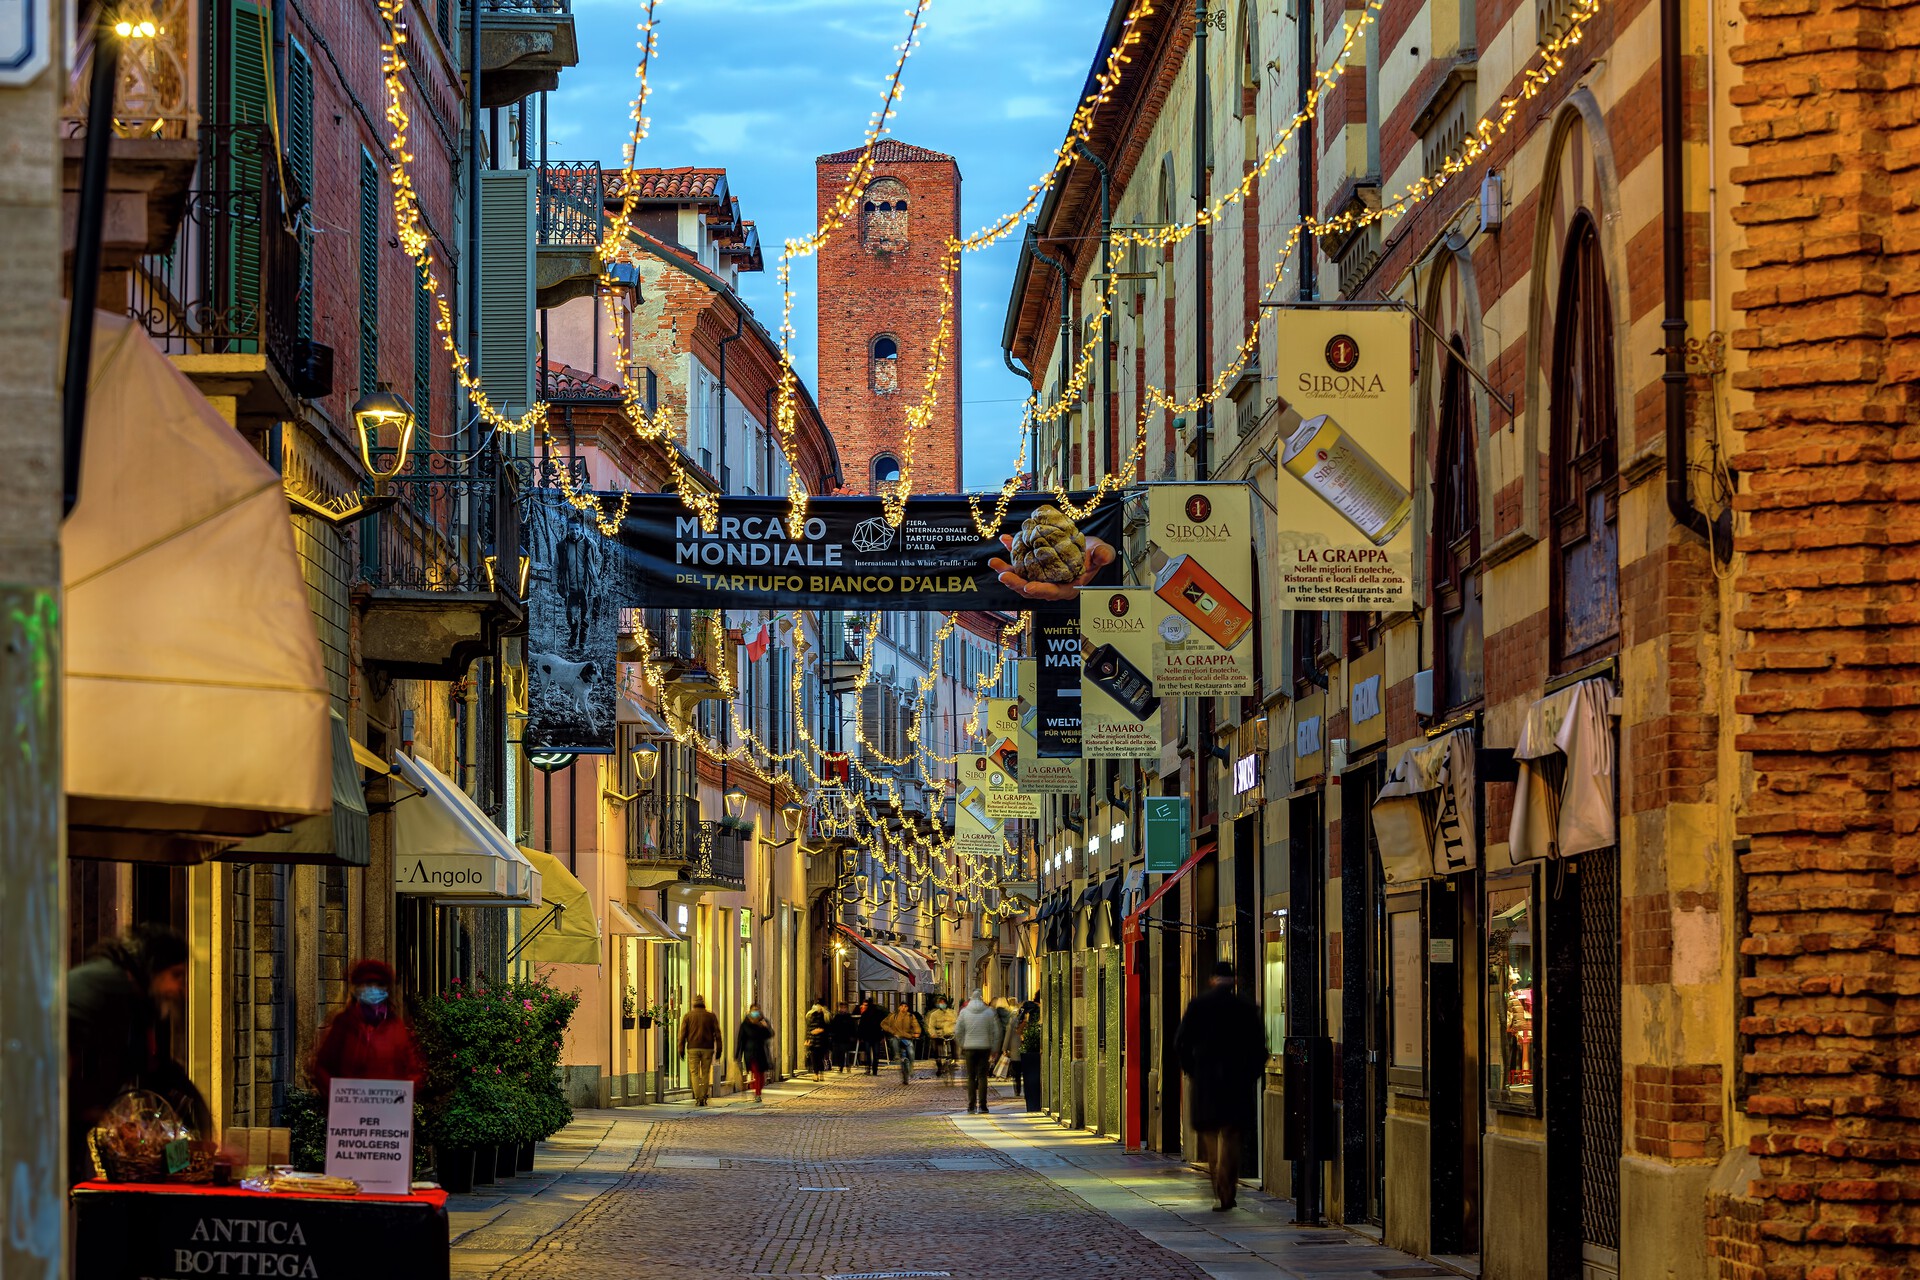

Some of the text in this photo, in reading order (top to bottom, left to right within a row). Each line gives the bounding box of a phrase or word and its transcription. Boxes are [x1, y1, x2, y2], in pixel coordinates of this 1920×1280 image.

[1298, 372, 1386, 393] SIBONA
[1313, 446, 1349, 482] SIBONA
[1165, 523, 1231, 538] SIBONA
[676, 542, 843, 566] MONDIALE
[1298, 549, 1388, 563] LA GRAPPA
[855, 559, 898, 567] International
[899, 559, 915, 567] Alba
[917, 559, 937, 567] White
[938, 559, 962, 567] Truffle
[1294, 565, 1395, 576] Nelle migliori Enoteche,
[676, 574, 978, 593] DEL TARTUFO BIANCO D'ALBA
[1284, 575, 1323, 583] Ristoranti
[1333, 575, 1357, 583] locali
[1359, 575, 1380, 584] della
[1287, 585, 1403, 594] In the best Restaurants and
[1295, 594, 1316, 603] wine
[1318, 595, 1344, 603] stores
[1345, 594, 1356, 603] of
[1357, 594, 1371, 603] the
[1092, 617, 1144, 629] SIBONA
[1043, 627, 1073, 635] WHITE
[1167, 655, 1236, 666] LA GRAPPA
[1182, 667, 1208, 676] migliori
[1044, 729, 1059, 737] FÜR
[1098, 724, 1144, 733] L'AMARO
[1028, 766, 1072, 774] LA GRAPPA
[335, 1088, 407, 1097] ANTICA BOTTEGA
[353, 1096, 393, 1104] TARTUFO
[359, 1117, 380, 1126] PER
[330, 1128, 409, 1138] TARTUFI FRESCHI
[338, 1140, 400, 1149] RIVOLGERSI
[335, 1151, 402, 1161] ALL'INTERNO
[190, 1218, 307, 1246] ANTICA
[174, 1248, 319, 1279] BOTTEGA
